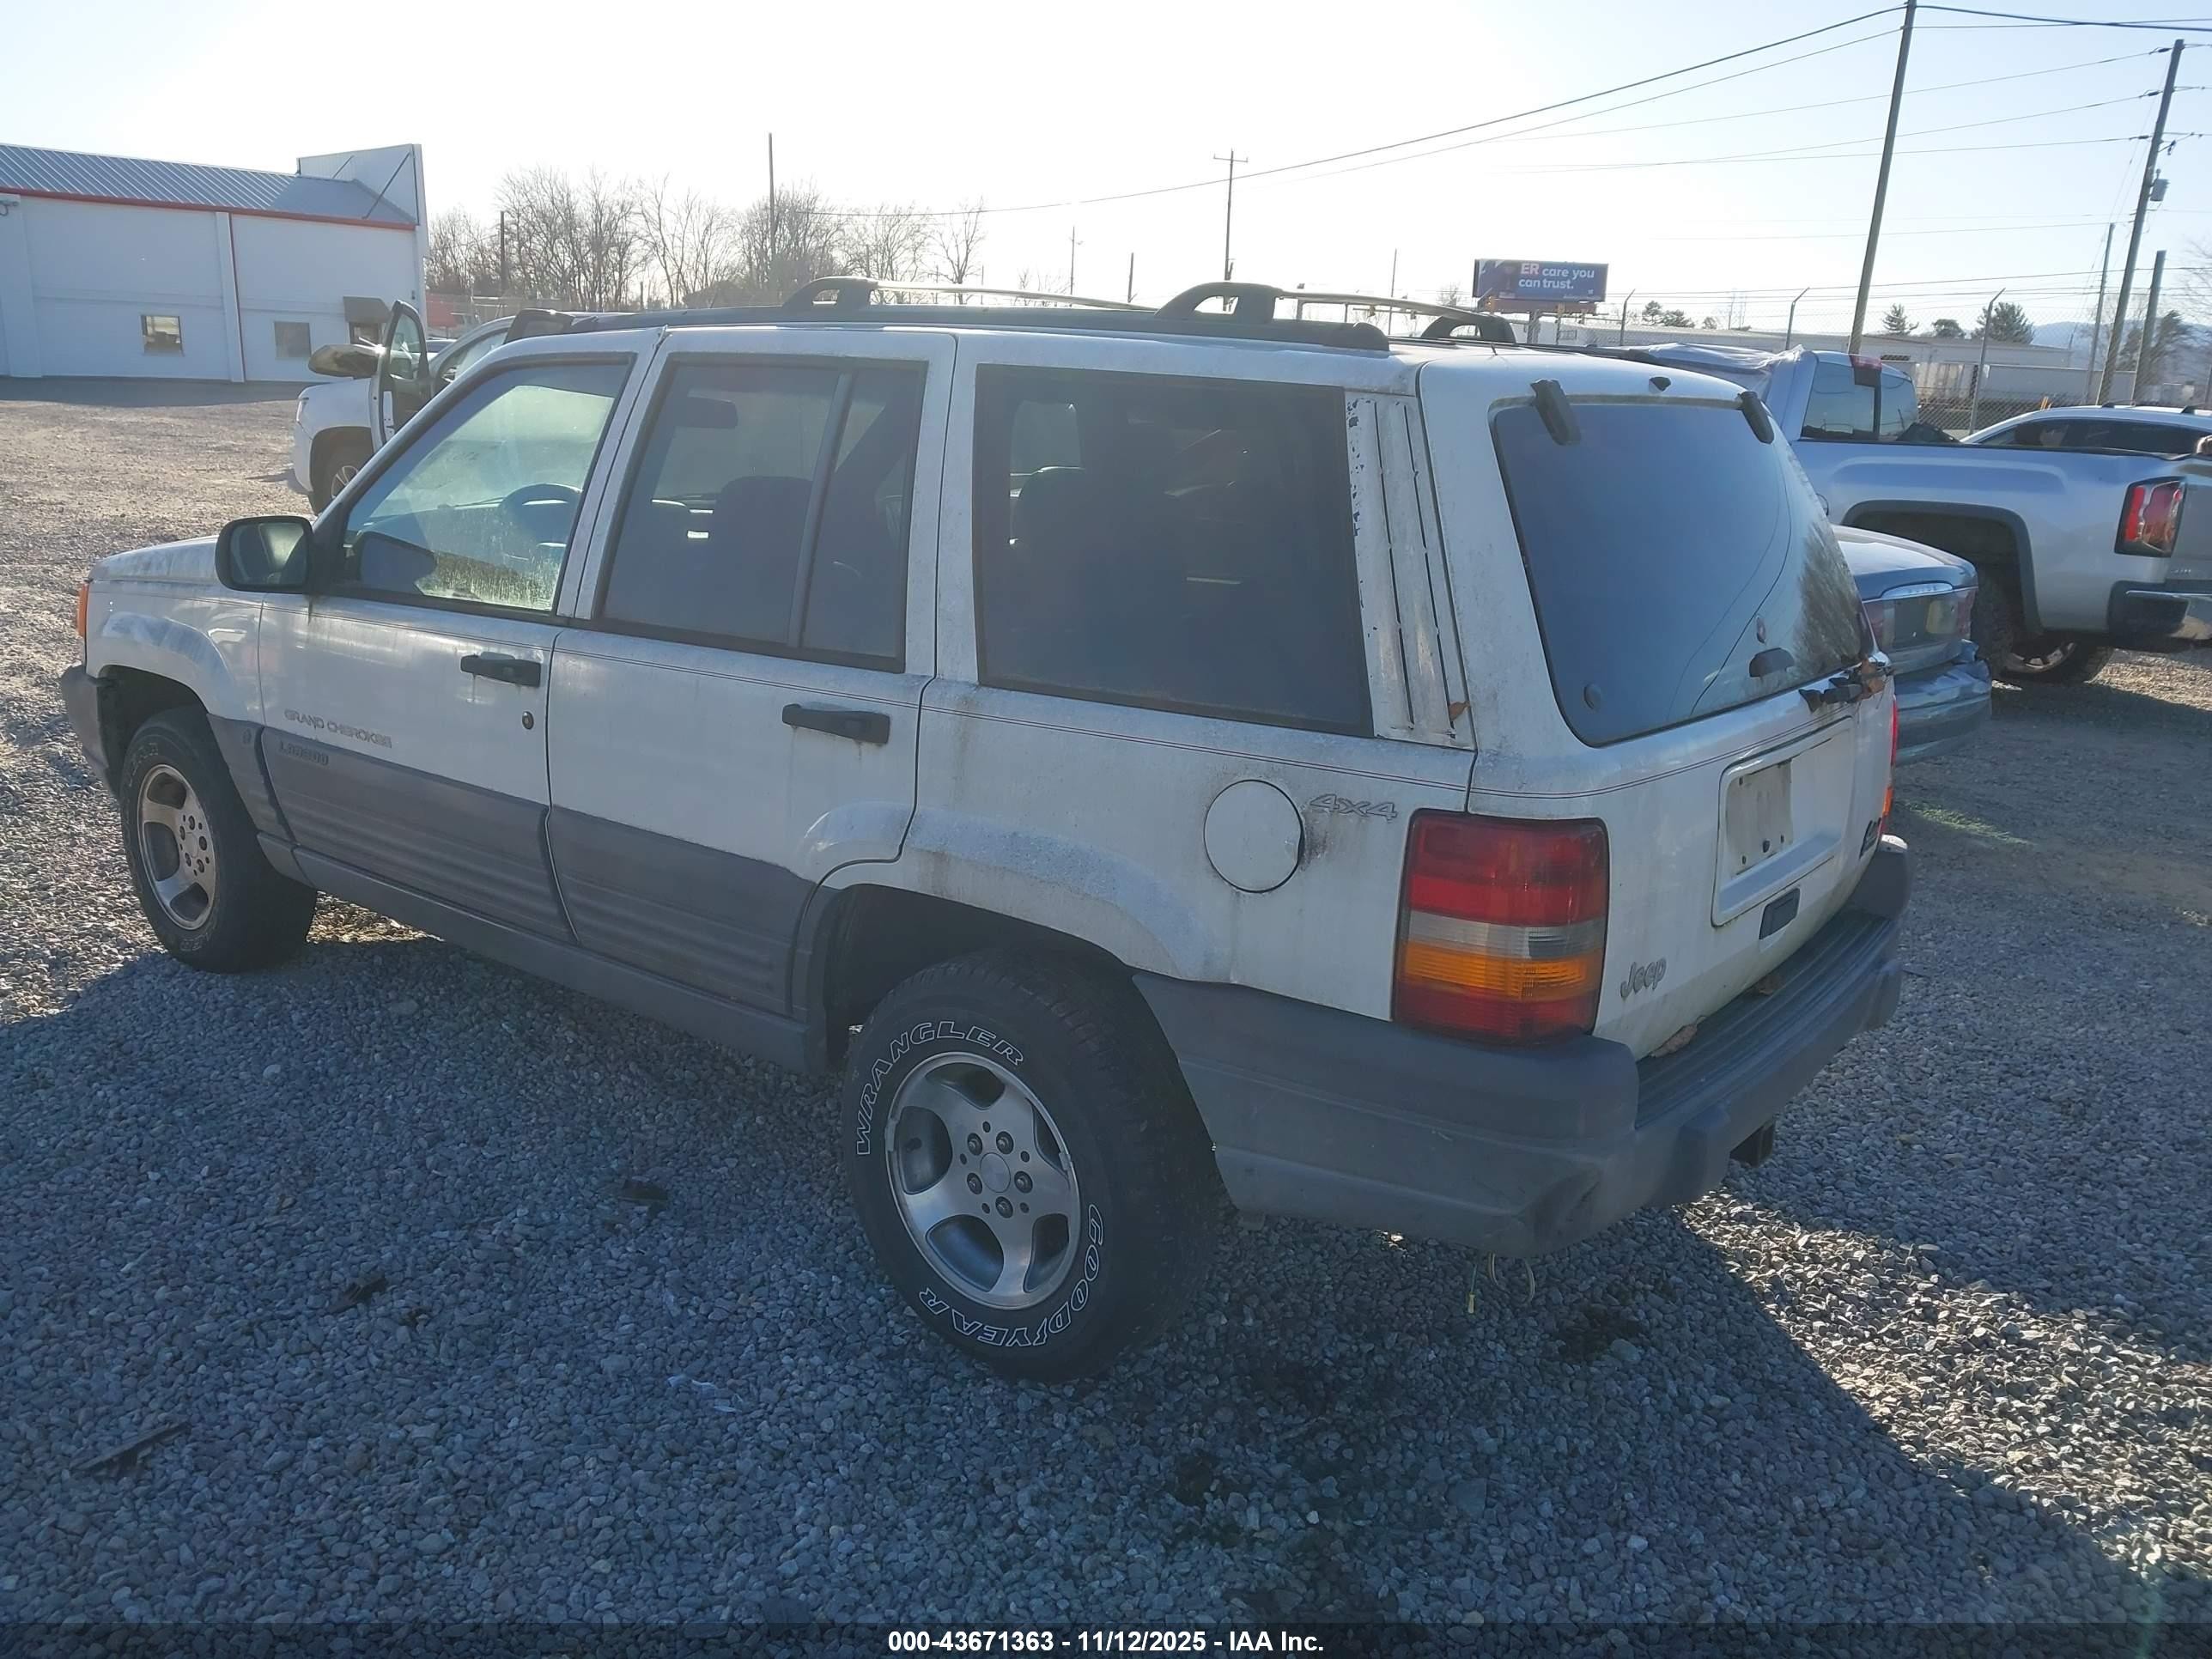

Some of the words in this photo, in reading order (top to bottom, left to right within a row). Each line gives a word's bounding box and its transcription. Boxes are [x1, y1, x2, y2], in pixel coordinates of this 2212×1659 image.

[1518, 279, 1540, 288] can
[1542, 279, 1574, 289] trust.
[1521, 263, 1539, 275] ER
[1542, 268, 1569, 277] care
[1572, 270, 1595, 280] you
[284, 708, 325, 729] GRAND
[327, 720, 392, 749] CHEROKEE
[1620, 957, 1667, 999] Jeep
[855, 1020, 1025, 1155] WRANGLER
[919, 1203, 1104, 1347] GOODYEAR
